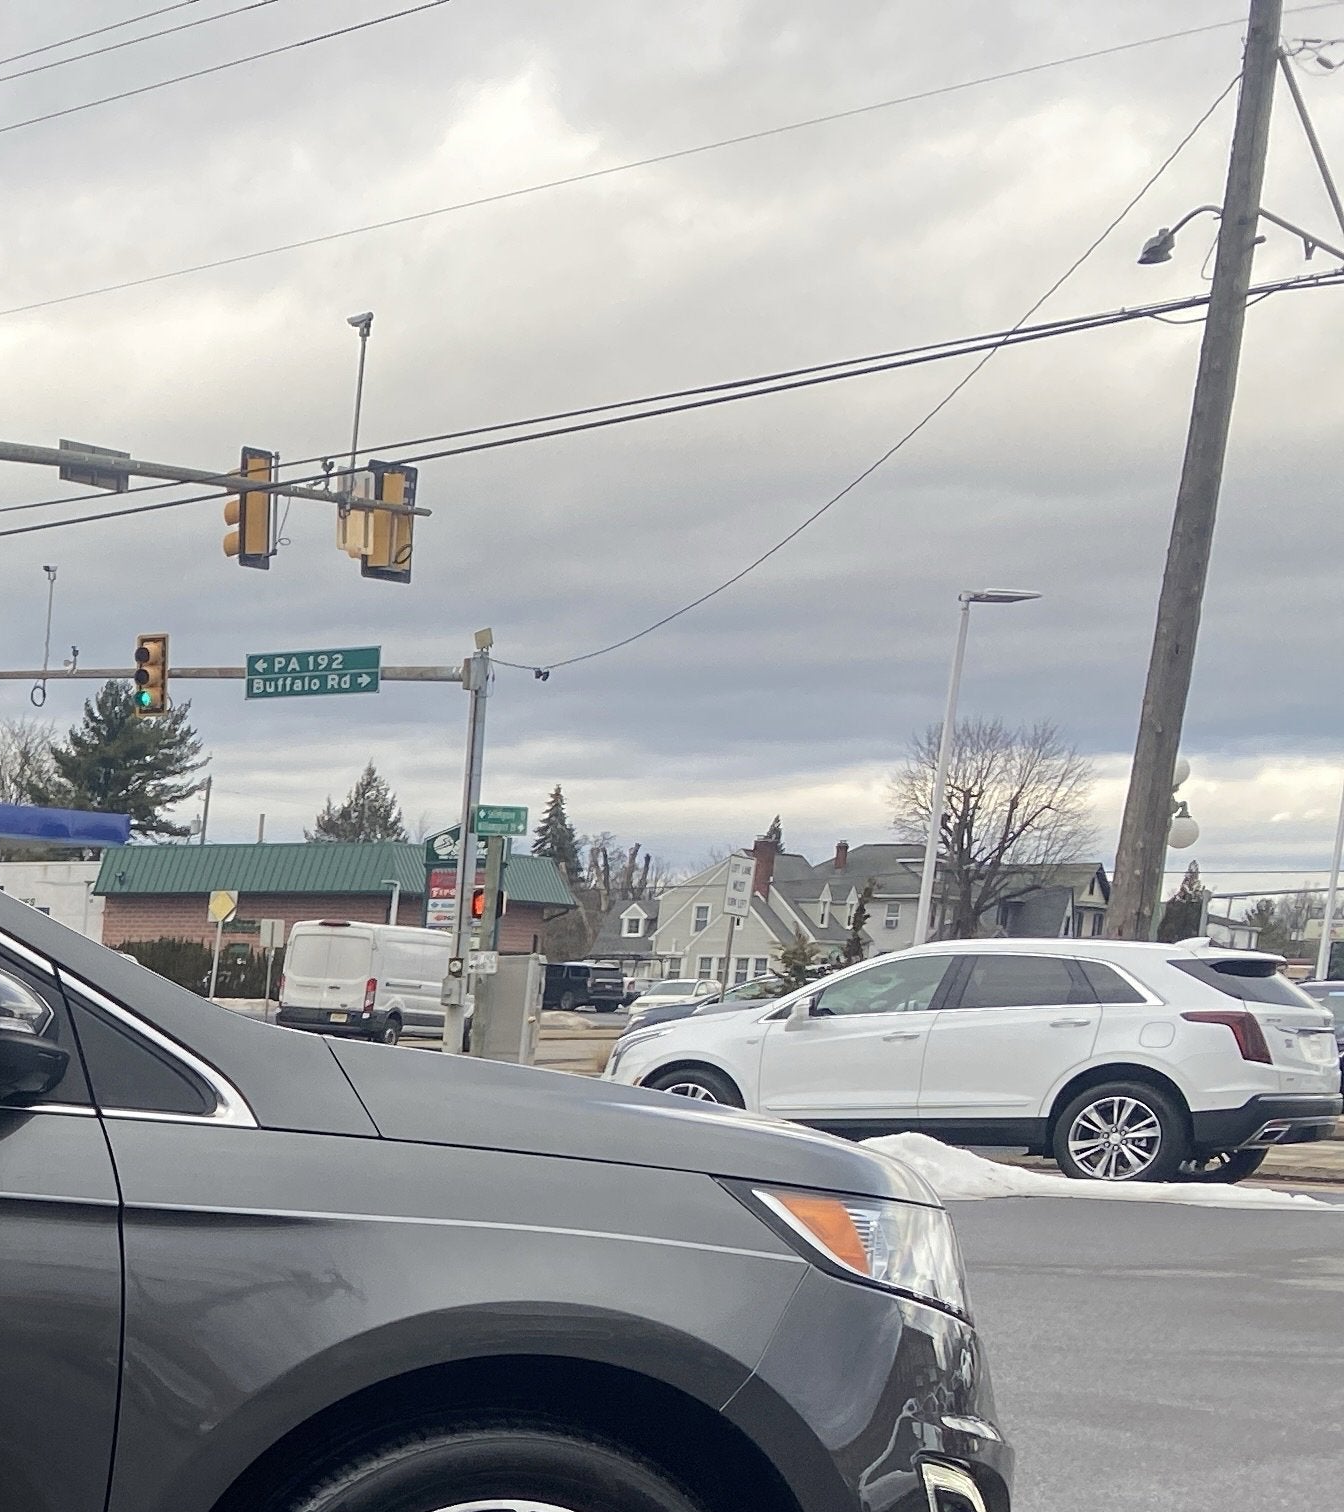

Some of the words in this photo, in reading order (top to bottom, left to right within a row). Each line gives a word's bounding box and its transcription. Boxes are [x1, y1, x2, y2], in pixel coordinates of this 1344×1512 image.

[274, 656, 300, 673] PA
[308, 653, 344, 671] 192
[252, 675, 321, 694] Buffalo
[327, 674, 351, 690] Rd
